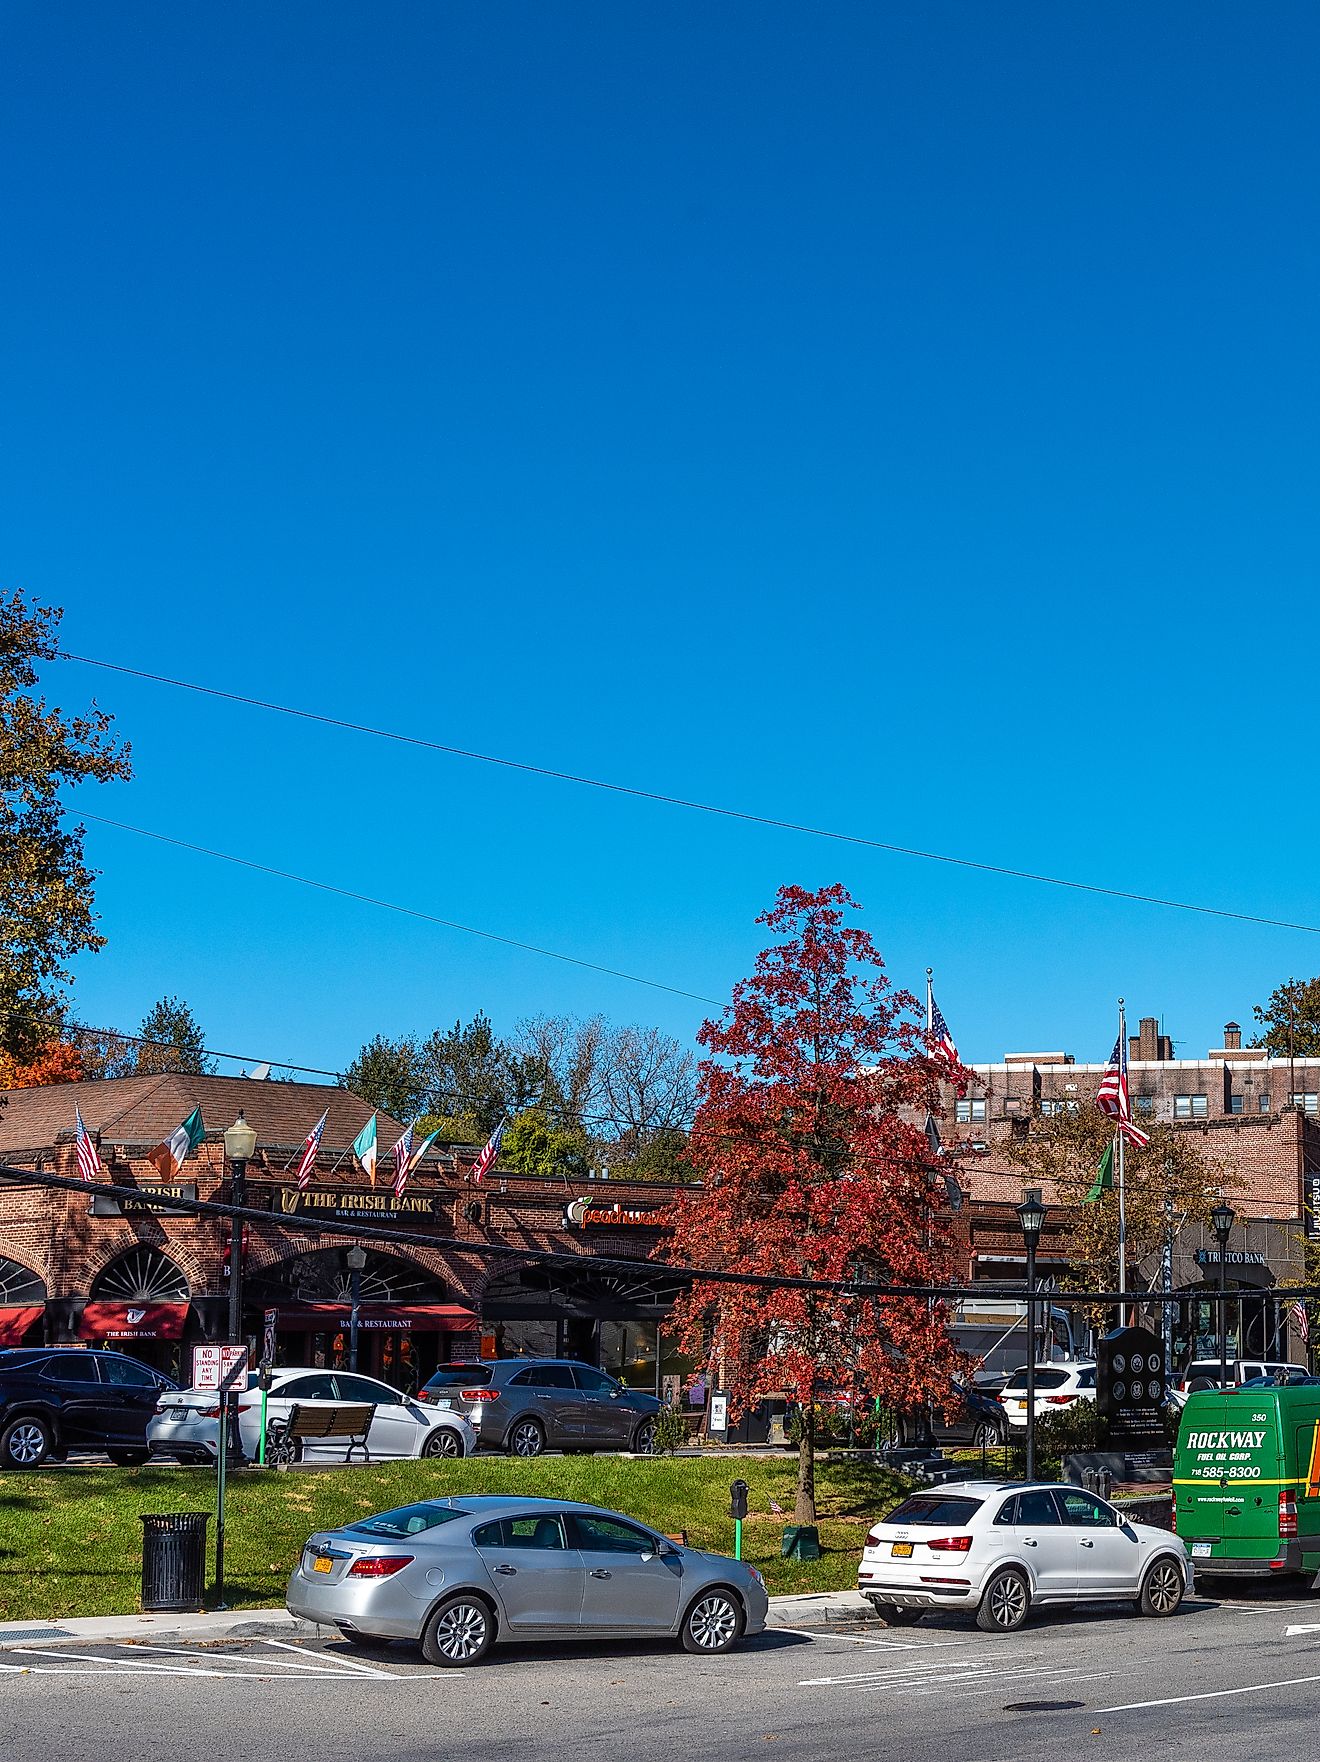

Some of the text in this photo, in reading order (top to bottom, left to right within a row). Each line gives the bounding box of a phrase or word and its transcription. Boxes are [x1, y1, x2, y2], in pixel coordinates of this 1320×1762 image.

[302, 1192, 434, 1213] THE IRISH BANK
[335, 1209, 348, 1217] BAR
[356, 1210, 398, 1219] RESTAURANT
[1244, 1252, 1265, 1264] BANK
[202, 1349, 213, 1358] NO
[222, 1349, 230, 1358] NO
[1187, 1432, 1266, 1448] ROCKWAY
[1197, 1453, 1214, 1461] FUEL
[1216, 1453, 1227, 1461] OIL
[1202, 1467, 1260, 1477] 585-8300
